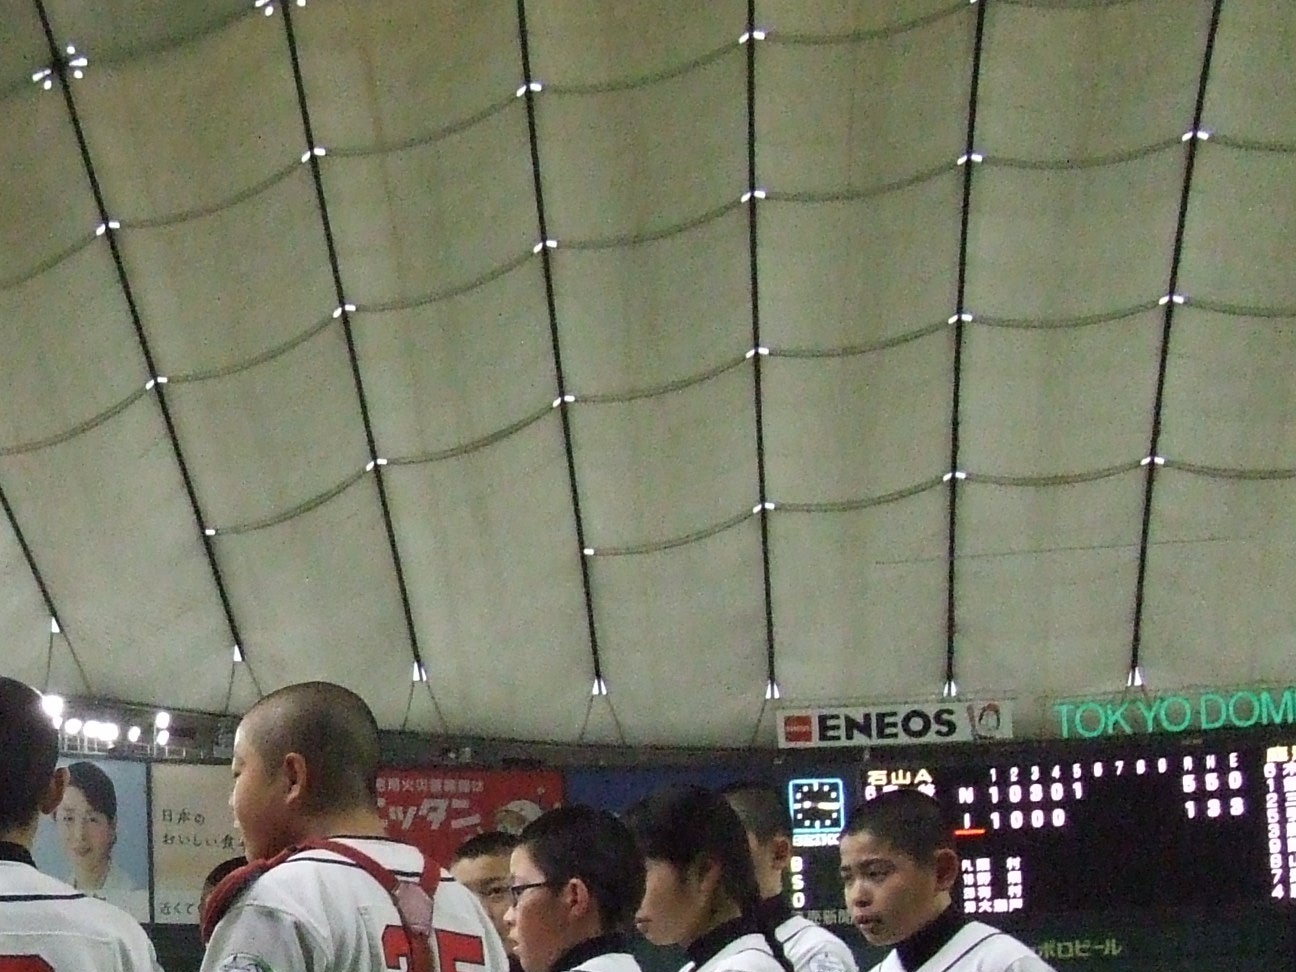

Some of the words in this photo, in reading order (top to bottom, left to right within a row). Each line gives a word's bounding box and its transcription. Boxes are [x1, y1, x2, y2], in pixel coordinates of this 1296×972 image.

[817, 708, 957, 742] ENEOS
[1053, 697, 1191, 739] TOKYO
[989, 767, 997, 783] 1
[1009, 766, 1019, 782] 2
[1030, 765, 1040, 781] 3
[1051, 764, 1061, 779] 4
[1072, 763, 1082, 779] 5
[1114, 760, 1124, 776] 7
[1229, 752, 1238, 768] E
[988, 785, 999, 804] 1
[1008, 784, 1022, 803] 0
[1050, 782, 1064, 801] 0
[1072, 781, 1083, 800] 1
[1182, 774, 1197, 793] 5
[1204, 772, 1220, 792] 5
[1228, 770, 1243, 790] 0
[989, 811, 1000, 830] 1
[1010, 810, 1024, 829] 0
[1030, 809, 1045, 828] 0
[1051, 808, 1066, 827] 0
[1184, 800, 1196, 819] 1
[1206, 798, 1221, 818] 3
[1229, 796, 1245, 816] 3
[791, 873, 805, 891] S
